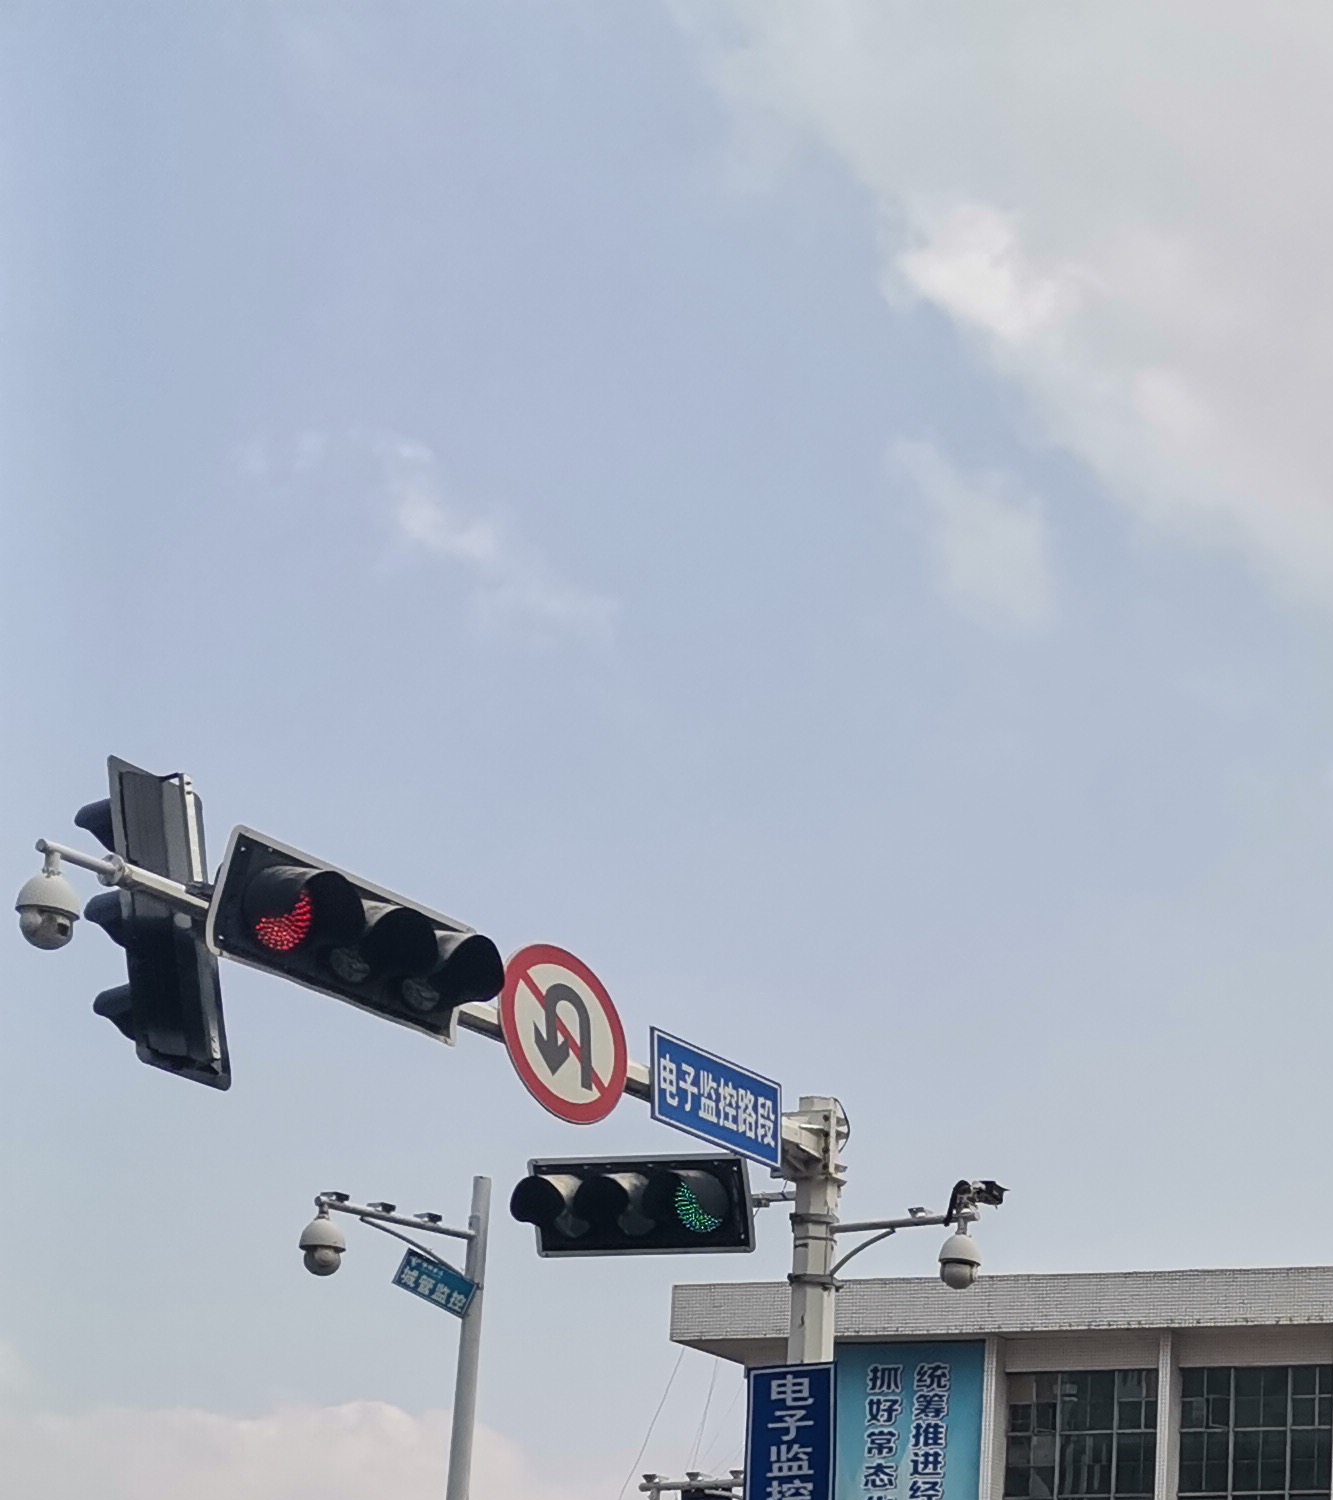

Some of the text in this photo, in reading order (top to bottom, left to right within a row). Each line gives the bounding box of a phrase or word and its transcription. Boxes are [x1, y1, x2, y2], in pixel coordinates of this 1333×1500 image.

[659, 1053, 776, 1148] 电子监控路段
